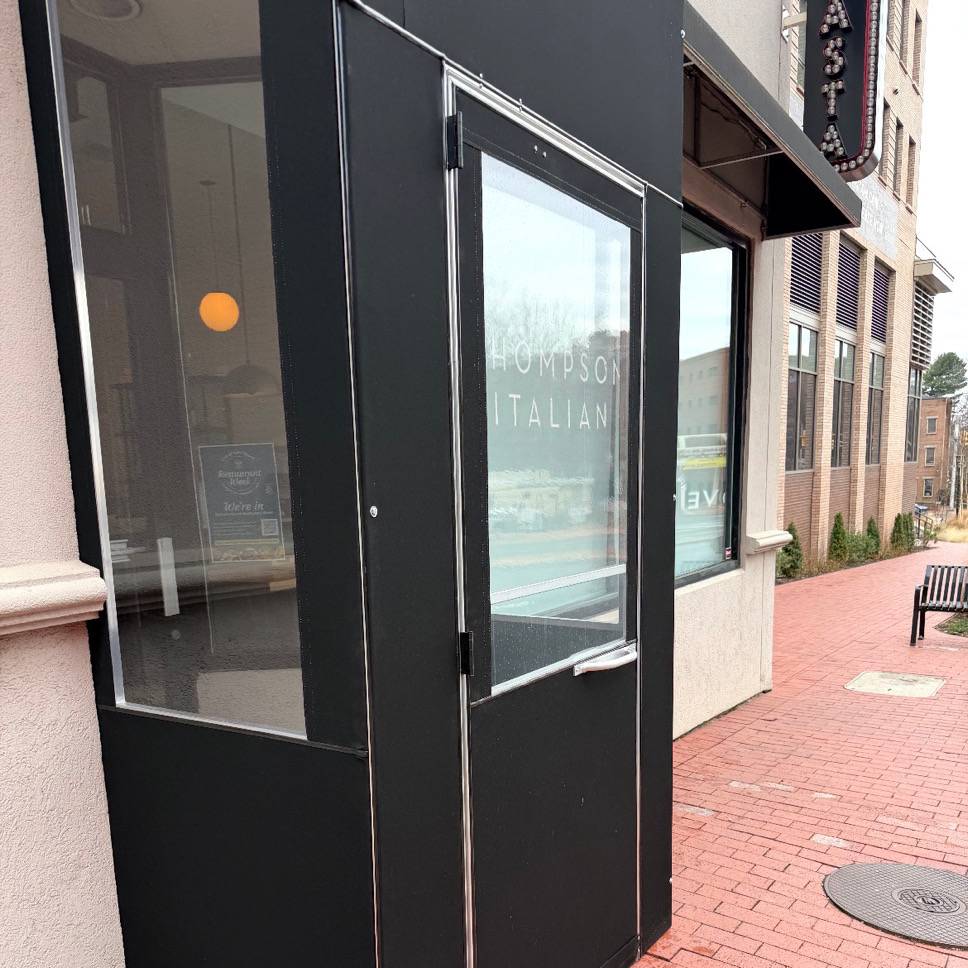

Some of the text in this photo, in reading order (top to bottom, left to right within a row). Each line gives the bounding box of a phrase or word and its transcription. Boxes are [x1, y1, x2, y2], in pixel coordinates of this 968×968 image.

[494, 392, 607, 430] ITALIAN
[230, 477, 251, 486] Week
[224, 501, 265, 512] We're in
